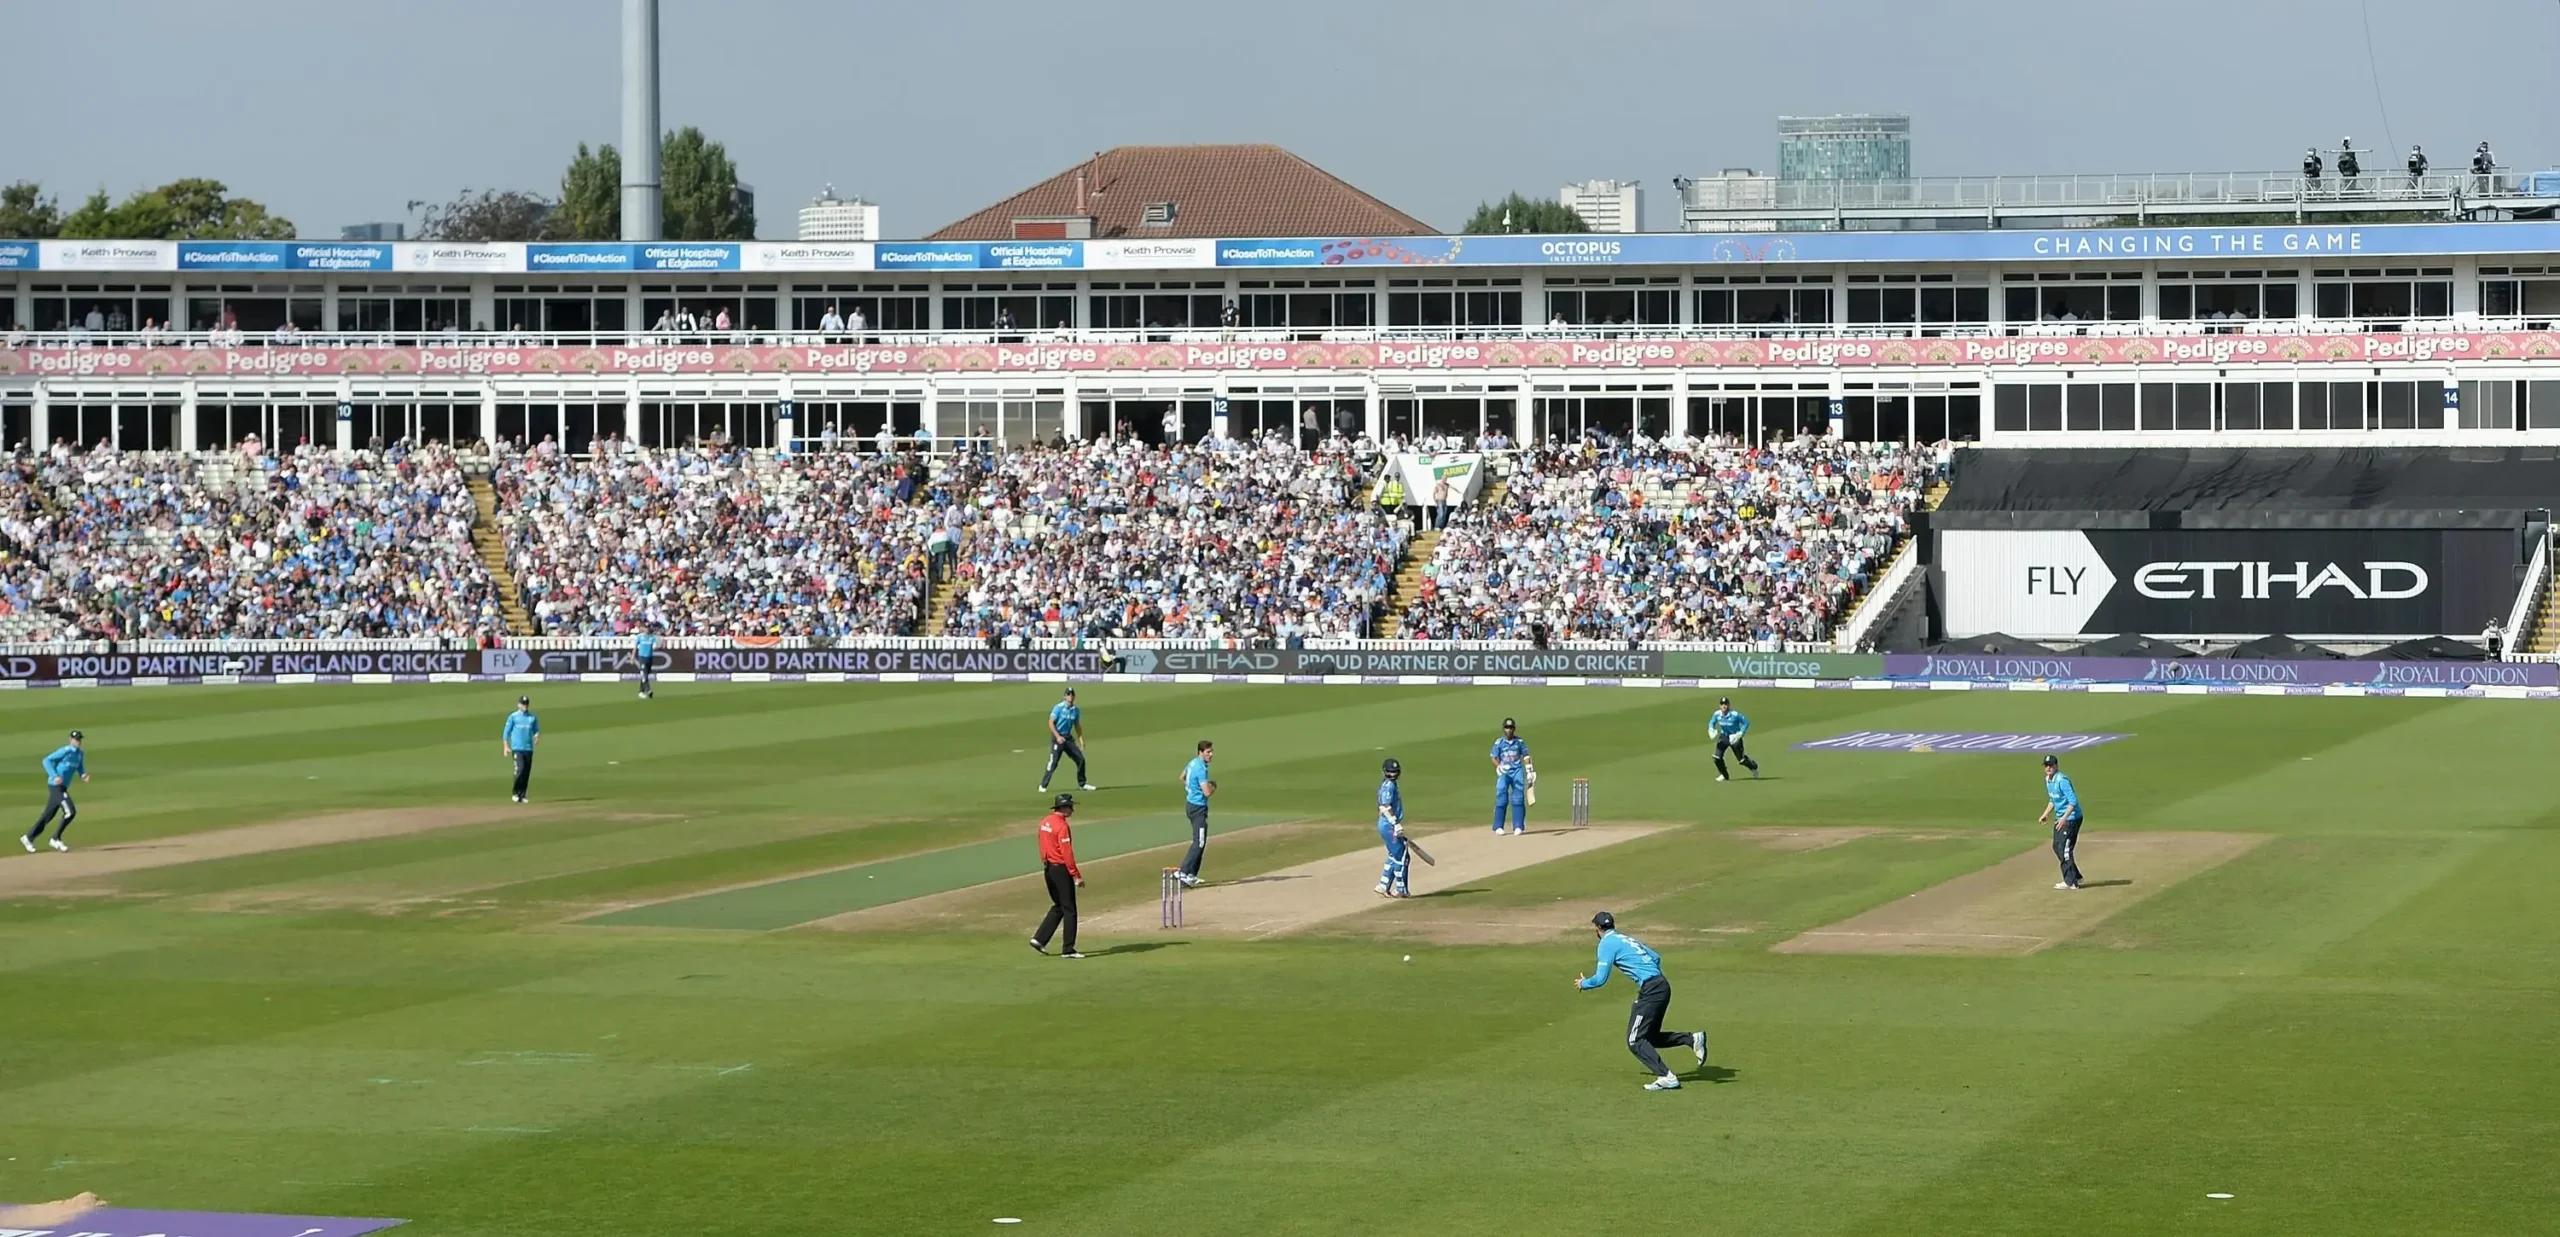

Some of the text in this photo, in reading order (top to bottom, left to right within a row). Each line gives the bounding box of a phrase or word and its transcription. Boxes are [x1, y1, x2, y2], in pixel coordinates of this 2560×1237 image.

[1123, 246, 1196, 255] Keith Prowse
[1541, 241, 1621, 255] OCTOPUS
[2034, 232, 2362, 254] CHANGING THE GAME
[81, 247, 157, 258] Keith Prowse
[184, 251, 279, 264] #CloserToTheAction
[297, 247, 382, 260] Official Hospitality
[433, 249, 507, 259] Keith Prowse
[533, 253, 627, 264] #CloserToTheAction
[645, 247, 729, 260] Official Hospitality
[780, 248, 855, 258] Keith Prowse
[881, 252, 973, 263] #CloserToTheAction
[990, 245, 1073, 258] Official Hospitality
[1222, 247, 1315, 259] #CloserToTheAction
[1550, 255, 1612, 263] INVESTMENTS
[668, 258, 718, 270] Edgbaston
[1012, 257, 1062, 268] Edgbaston
[1379, 344, 1480, 368] Pedigree
[1572, 343, 1675, 367] Pedigree
[1768, 342, 1872, 365] Pedigree
[1966, 341, 2069, 364] Pedigree
[2163, 338, 2268, 363] Pedigree
[2363, 336, 2471, 361] Pedigree
[28, 351, 132, 374] Pedigree
[225, 351, 328, 373] Pedigree
[421, 350, 521, 372] Pedigree
[613, 349, 714, 372] Pedigree
[807, 349, 908, 372] Pedigree
[998, 347, 1097, 370] Pedigree
[1187, 346, 1287, 369] Pedigree
[2444, 392, 2458, 404] 14
[338, 405, 352, 418] 10
[779, 403, 792, 415] 11
[1214, 400, 1228, 413] 12
[1829, 402, 1843, 415] 13
[2027, 566, 2086, 596] FLY
[2133, 561, 2430, 599] ETIHAD
[58, 656, 131, 676] PROUD
[272, 653, 372, 673] ENGLAND
[378, 653, 466, 673] CRICKET
[493, 653, 519, 668] FLY
[695, 651, 1100, 671] PROUD PARTNER OF ENGLAND CRICKET
[1125, 654, 1147, 667] FLY
[1164, 653, 1279, 669] ETIHAD
[1368, 654, 1449, 671] PARTNER
[1453, 655, 1478, 671] OF
[1484, 655, 1570, 671] ENGLAND
[1574, 655, 1650, 671] CRICKET
[1727, 656, 1821, 676] Waitrose
[1936, 659, 2072, 677] ROYAL LONDON
[2221, 663, 2299, 681] LONDON
[2389, 665, 2529, 685] ROYAL LONDON
